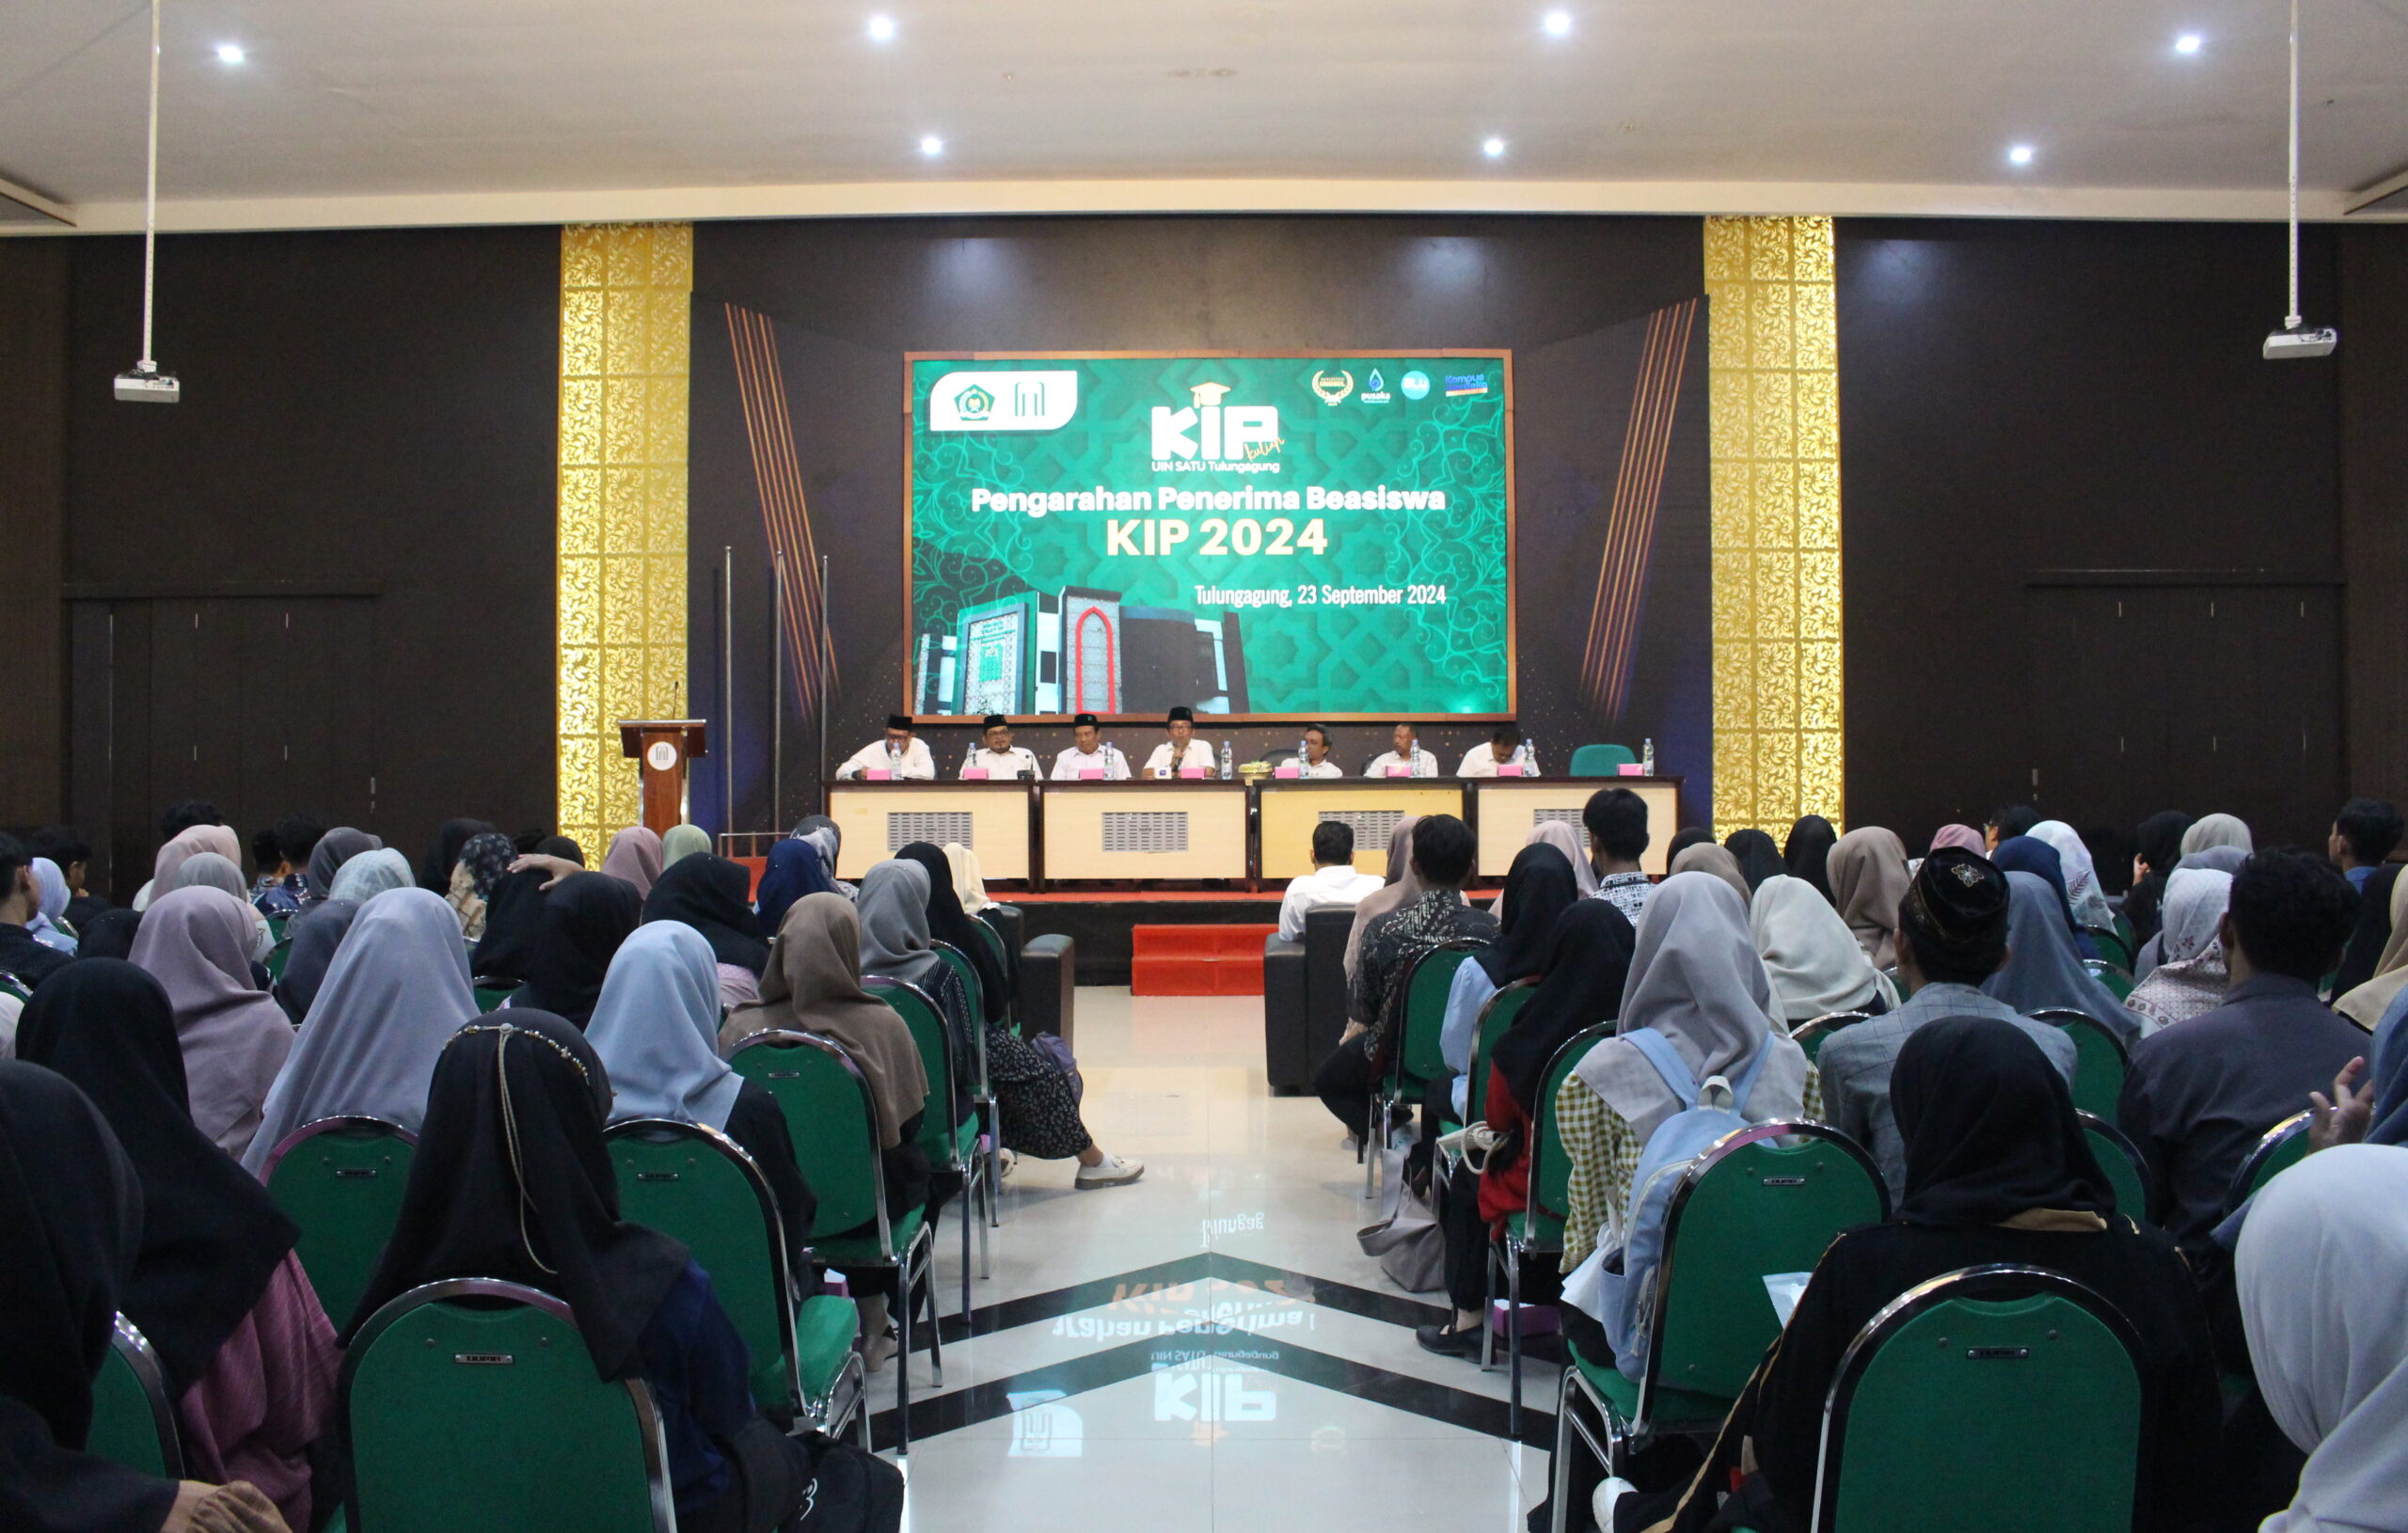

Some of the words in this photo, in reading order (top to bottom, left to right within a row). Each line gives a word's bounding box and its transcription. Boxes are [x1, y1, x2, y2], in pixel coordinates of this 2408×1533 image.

[1361, 391, 1391, 402] pusaka
[1151, 405, 1278, 460] KIP
[1151, 461, 1174, 472] UIN
[1175, 461, 1207, 472] SATU
[1208, 461, 1280, 474] Tulungagung
[972, 486, 1152, 517] Pengarahan
[1158, 485, 1300, 511] Penerima
[1307, 484, 1447, 511] Beasiswa
[1106, 518, 1191, 556] KIP
[1199, 517, 1329, 556] 2024
[1194, 585, 1293, 608] Tulungagung,
[1297, 584, 1318, 605] 23
[1322, 585, 1404, 608] September
[1407, 584, 1447, 605] 2024
